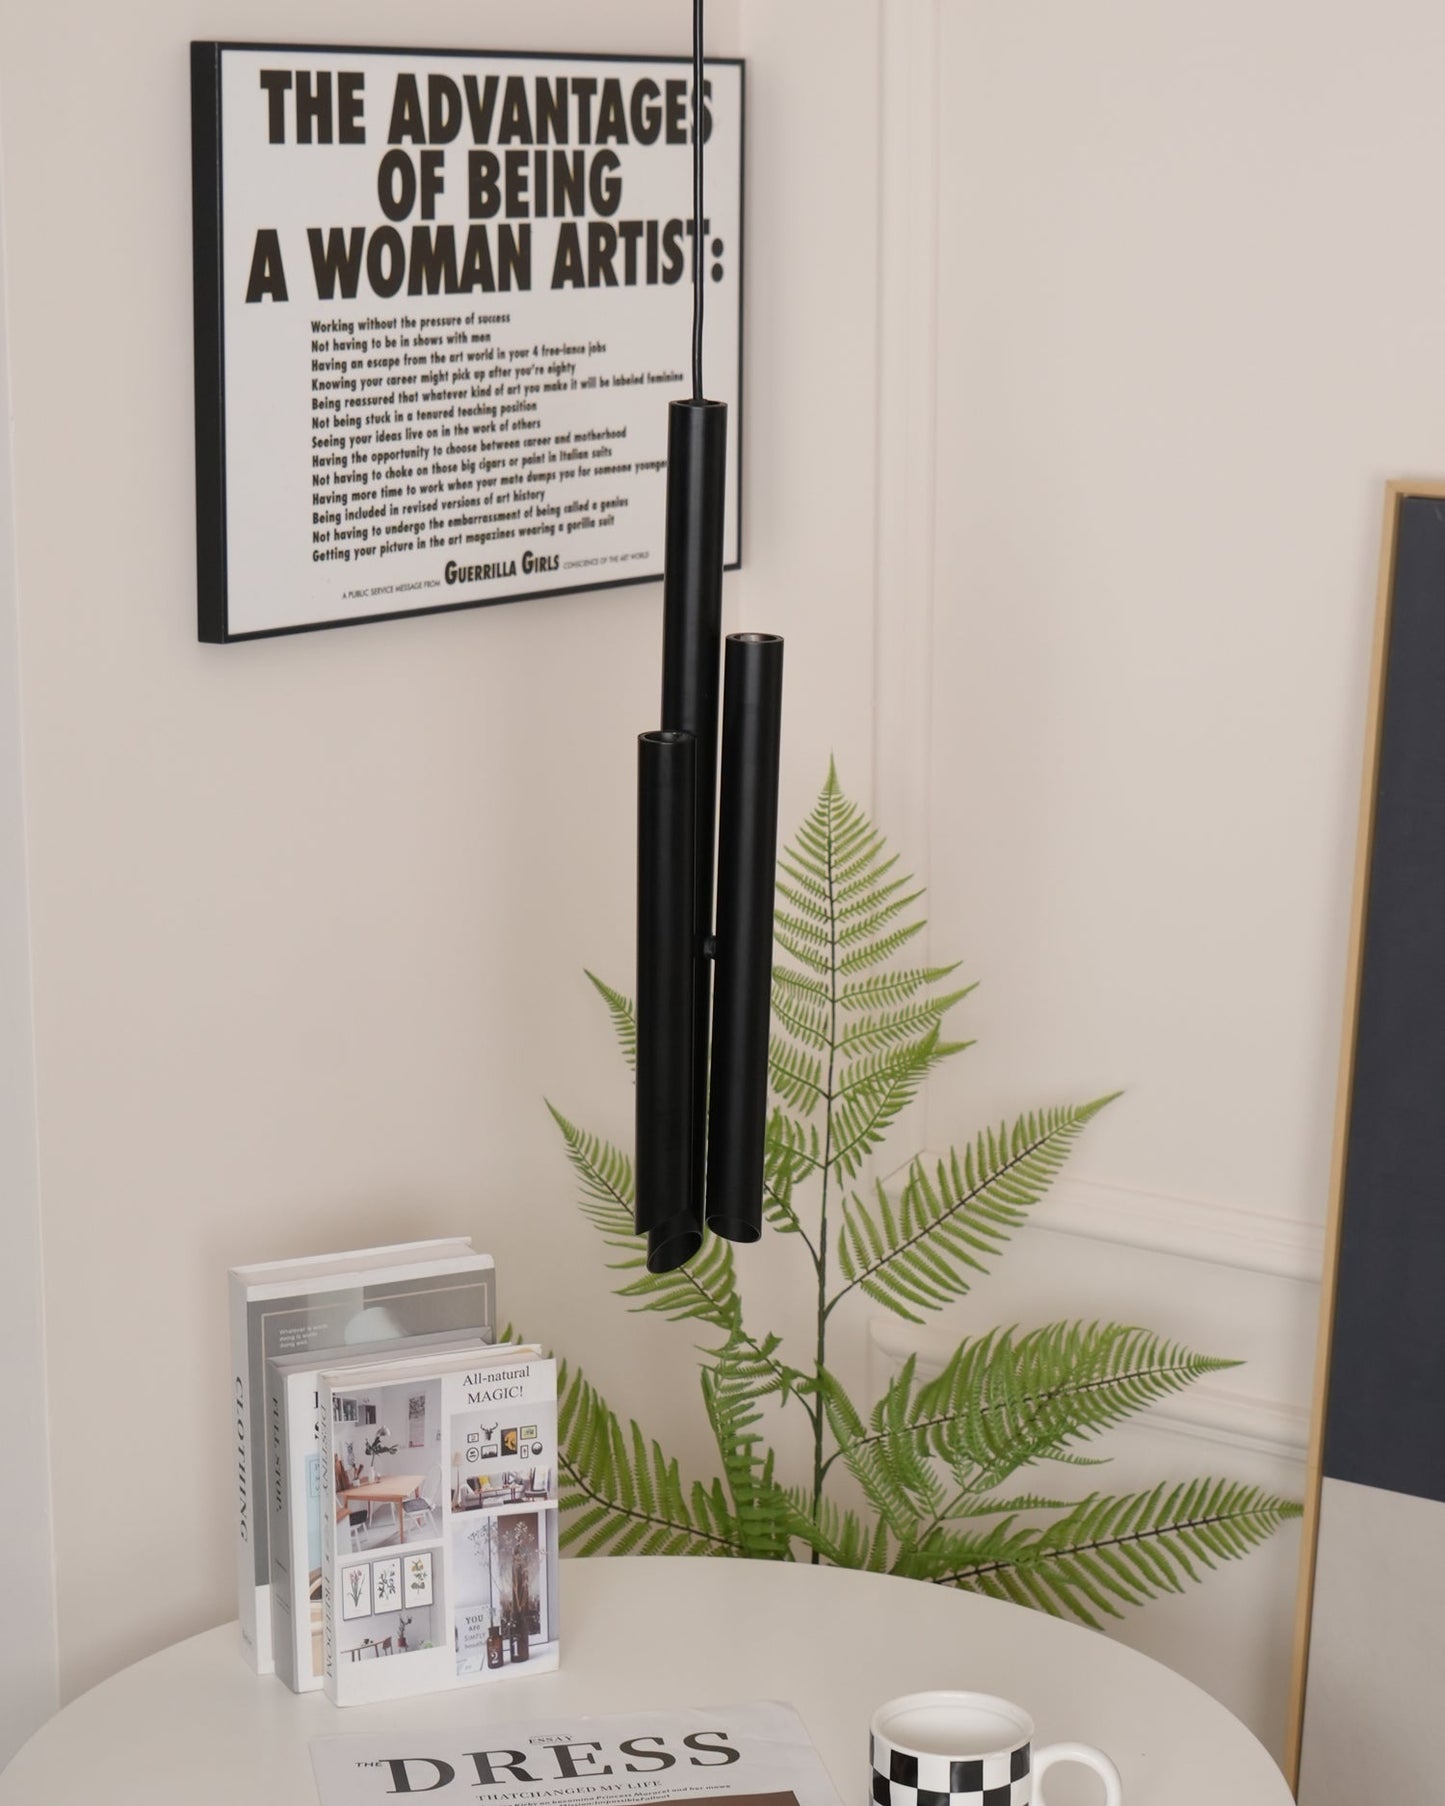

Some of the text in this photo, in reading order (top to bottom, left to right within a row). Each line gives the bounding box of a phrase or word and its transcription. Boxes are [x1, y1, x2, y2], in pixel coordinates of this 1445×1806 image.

[260, 69, 713, 146] THE ADVANTAGES
[377, 149, 622, 222] OF BEING
[245, 229, 289, 303] A
[306, 223, 531, 301] WOMAN
[311, 312, 509, 334] Working without the pressure of success
[311, 331, 490, 352] Not having to be in shows with men
[312, 341, 605, 373] Having an escape from the art world in your 4 free-lance jobs
[312, 362, 575, 391] Knowing your career might pick up after you're eighty
[312, 376, 609, 411] Being reassured that whatever kind of art you make it will be
[312, 400, 536, 429] Not being stuck in a tenured teaching position
[312, 418, 540, 449] Seeing your ideas live on in the work of others
[312, 427, 626, 468] Having the opportunity to choose between career and motherhood
[312, 451, 556, 486] Not having to choke on those big cigars or paint in
[312, 464, 631, 505] Having more time to work when your mate dumps you for someone
[312, 489, 544, 525] Being included in revised versions of art history
[312, 504, 560, 542] Not having to undergo the embarrassment of being
[312, 522, 554, 561] Getting your picture in the art magazines wearing
[348, 550, 560, 599] PUBLIC SERVICE MESSAGE FROM GUERRILLA GIRLS
[463, 1365, 530, 1386] All-natural
[467, 1385, 523, 1404] MAGIC!
[235, 1375, 248, 1543] CLOTHING
[465, 1614, 483, 1624] YOU
[491, 1651, 499, 1664] 2
[378, 1731, 740, 1794] DRESS
[475, 1785, 597, 1801] THATCHANGED
[600, 1783, 623, 1792] MY
[627, 1780, 662, 1790] LIFE
